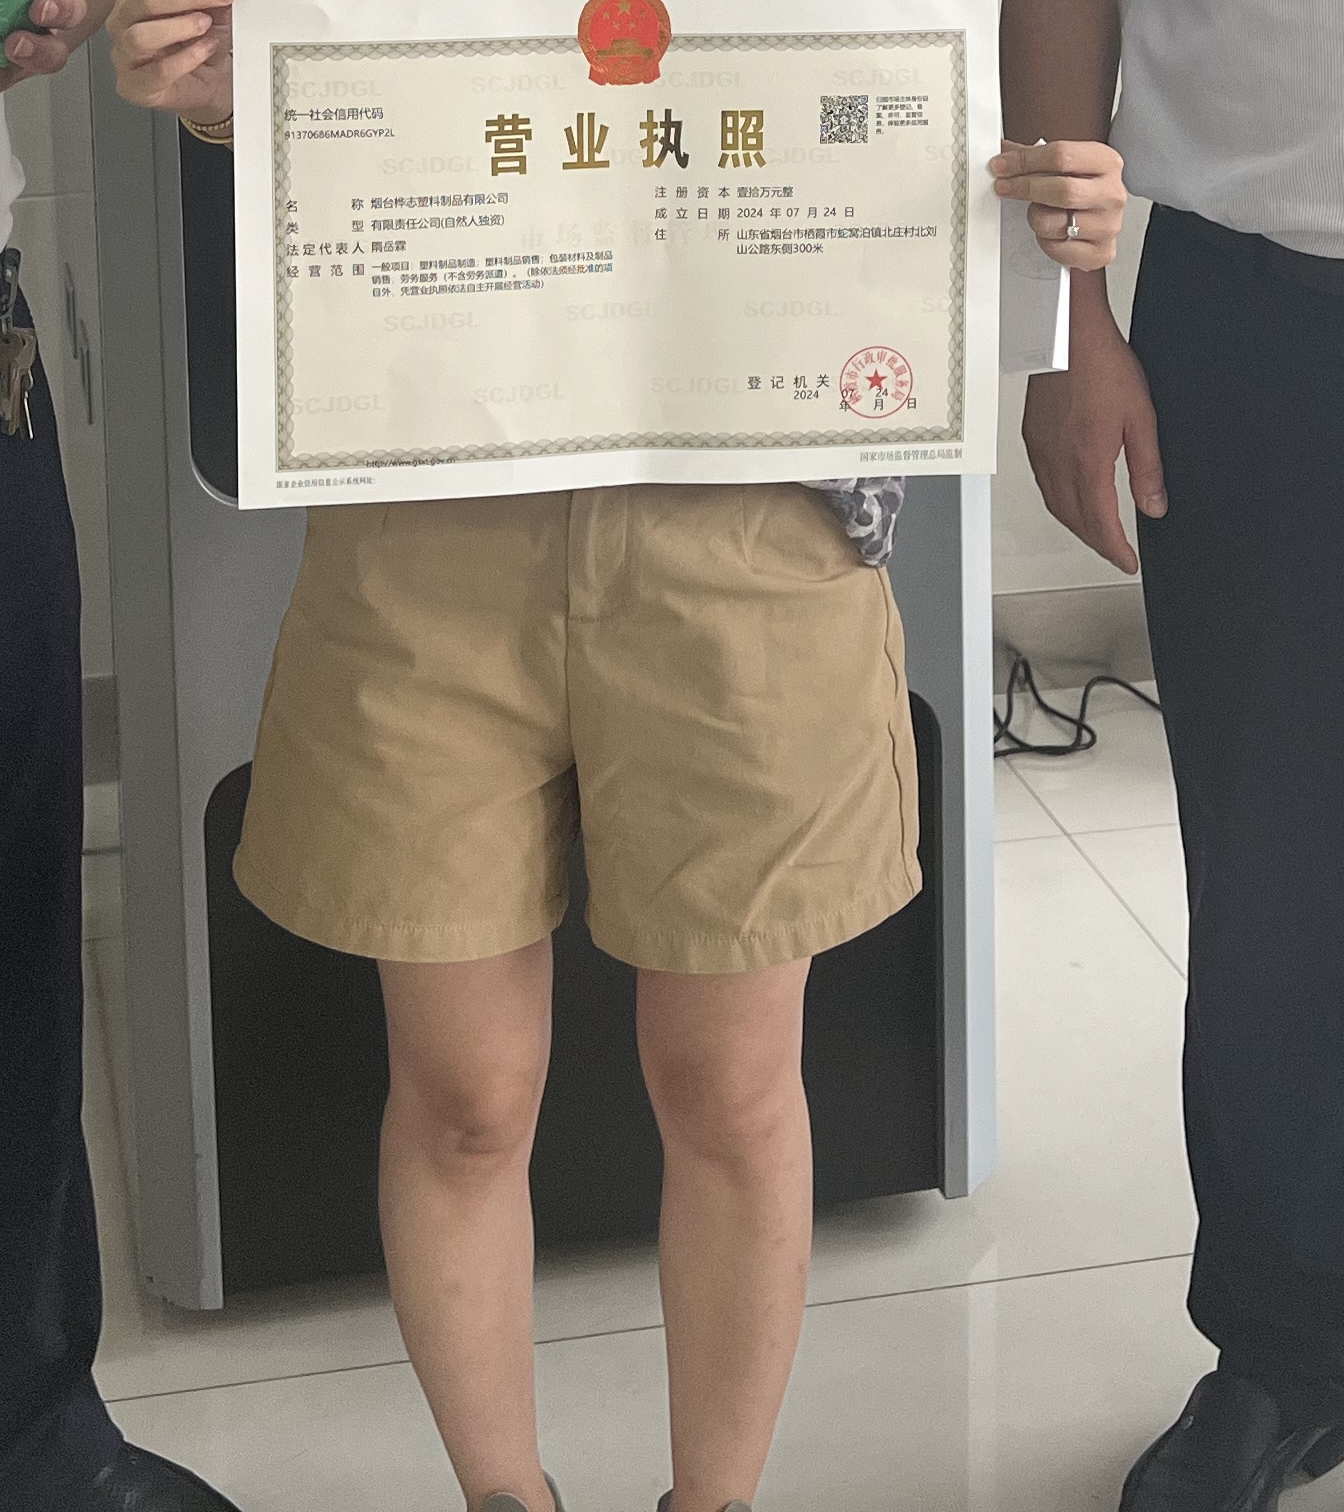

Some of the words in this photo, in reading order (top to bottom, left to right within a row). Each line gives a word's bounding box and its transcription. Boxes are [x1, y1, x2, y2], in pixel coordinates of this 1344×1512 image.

[285, 107, 384, 121] 统一社会信用代码
[485, 110, 767, 177] 营业执照
[655, 186, 730, 199] 注册资本
[737, 186, 794, 198] 壹拾万元整
[371, 193, 508, 210] 烟台桦志塑料制品有限公司
[655, 207, 730, 220] 成立日期
[286, 241, 364, 256] 法定代表人
[737, 243, 824, 255] 山公路东侧300米
[286, 264, 364, 278] 经营范围
[747, 374, 830, 390] 登记机关
[793, 390, 819, 400] 2024
[859, 449, 963, 463] 国家市场监督管理总局监制
